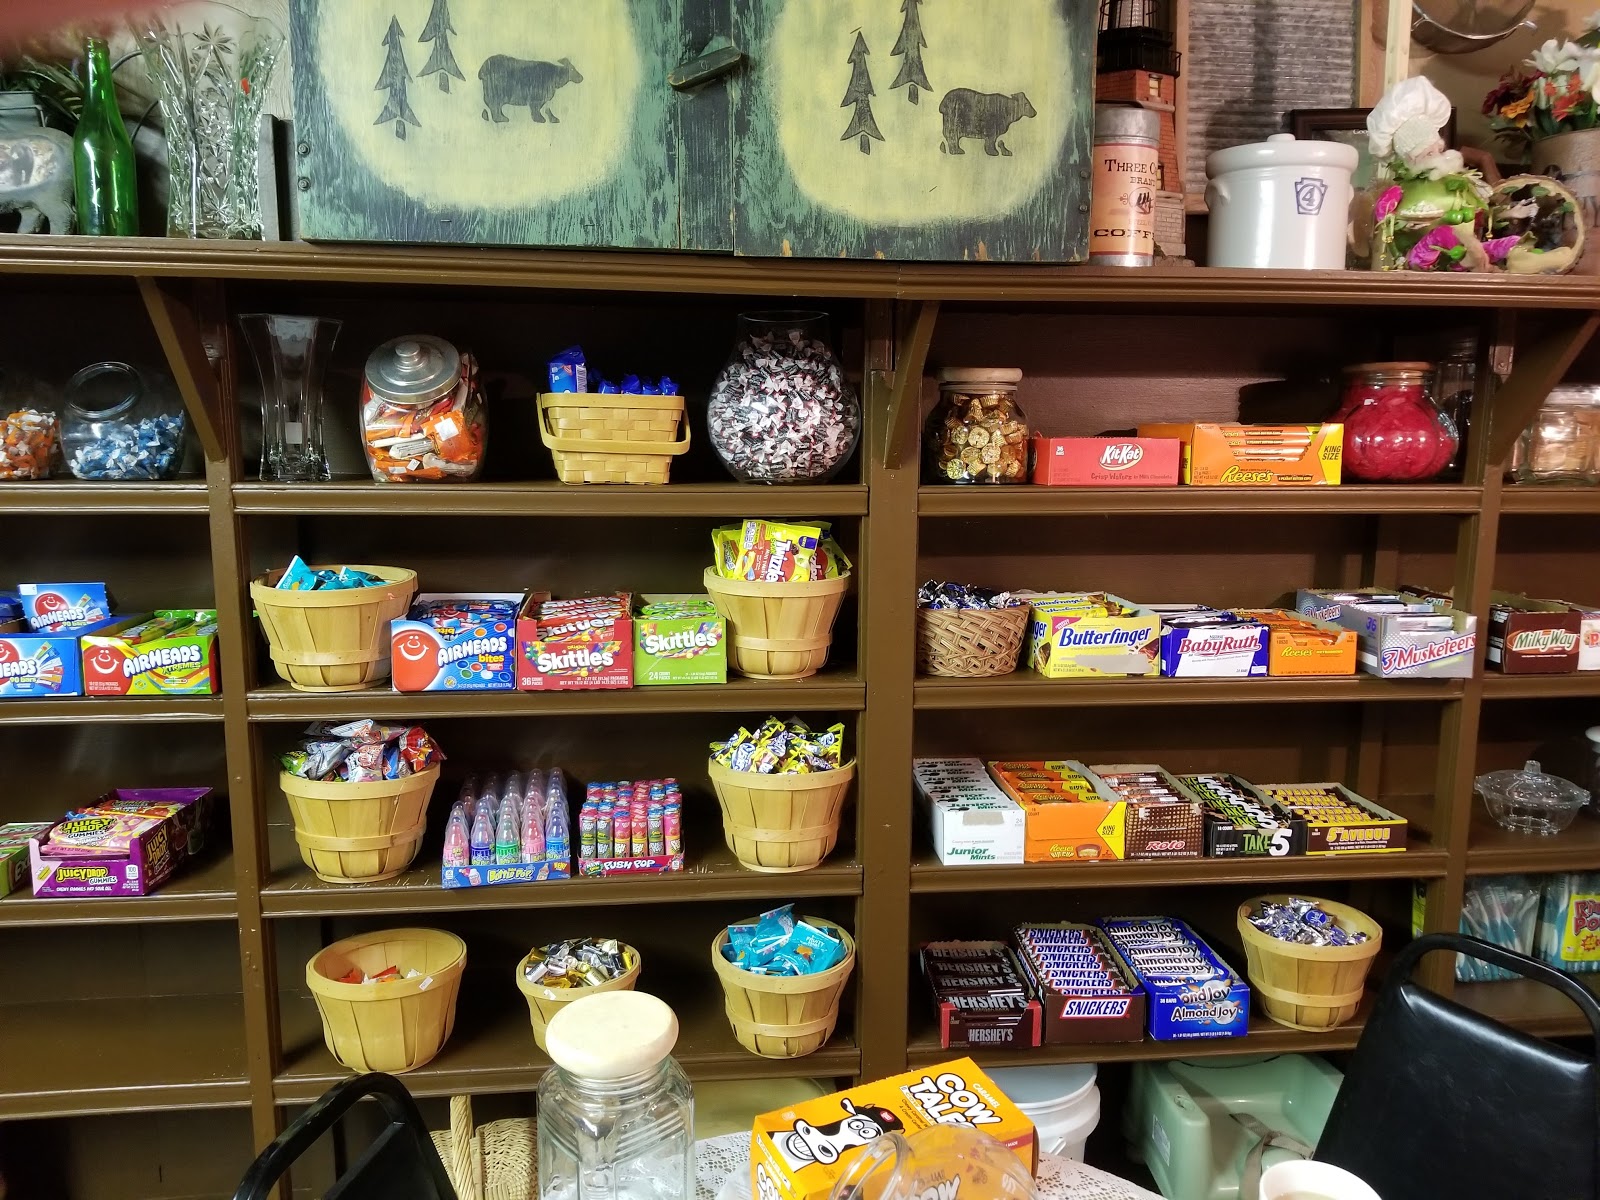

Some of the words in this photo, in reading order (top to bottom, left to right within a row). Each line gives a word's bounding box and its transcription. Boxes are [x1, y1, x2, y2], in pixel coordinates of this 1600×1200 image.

[1104, 158, 1148, 174] THREE
[1129, 176, 1156, 187] BRAN
[1300, 189, 1314, 206] 4
[1093, 228, 1156, 241] COFF
[1323, 445, 1342, 453] KING
[1091, 472, 1109, 481] Crisp
[1220, 464, 1274, 483] Reese's
[30, 607, 85, 630] AIRHEADS
[1365, 616, 1377, 632] 36
[537, 618, 614, 640] Skittles
[645, 629, 718, 654] Skittles
[1058, 627, 1152, 647] Butterfinger
[1514, 630, 1550, 651] Milky
[1550, 629, 1576, 651] Way
[437, 636, 508, 667] AIRHEADS
[478, 653, 505, 663] bites
[1381, 648, 1398, 675] 3
[1397, 632, 1477, 669] Musketeers
[122, 644, 202, 678] AIRHEADS
[537, 647, 614, 673] Skittles
[521, 677, 532, 686] 36
[648, 671, 659, 680] 24
[1242, 833, 1273, 851] TAKE
[1268, 828, 1293, 856] 5
[1340, 827, 1391, 842] AVENUE
[946, 847, 989, 856] Junior
[604, 860, 633, 870] PUSH
[633, 859, 656, 869] POP
[57, 867, 86, 881] JUICY
[86, 867, 107, 878] DROP
[89, 876, 118, 885] GUMMIES
[1575, 899, 1600, 918] Ri
[1029, 928, 1083, 938] SNICKERS
[1108, 923, 1155, 933] Almond
[1574, 917, 1600, 936] Po
[1041, 953, 1097, 963] SNICKERS
[1128, 946, 1176, 956] Almond
[1050, 970, 1109, 979] SNICKERS
[1055, 979, 1113, 987] SNICKERS
[947, 995, 1030, 1009] HERSHEY'S
[1181, 990, 1207, 1004] ond
[1207, 987, 1231, 1003] Joy
[1066, 1000, 1127, 1016] SNICKERS
[1171, 1006, 1217, 1021] Almond
[1217, 1006, 1237, 1019] Joy
[968, 1028, 1014, 1042] HERSHEY'S
[936, 1072, 1003, 1125] COW
[972, 1083, 1001, 1108] CARAMEL
